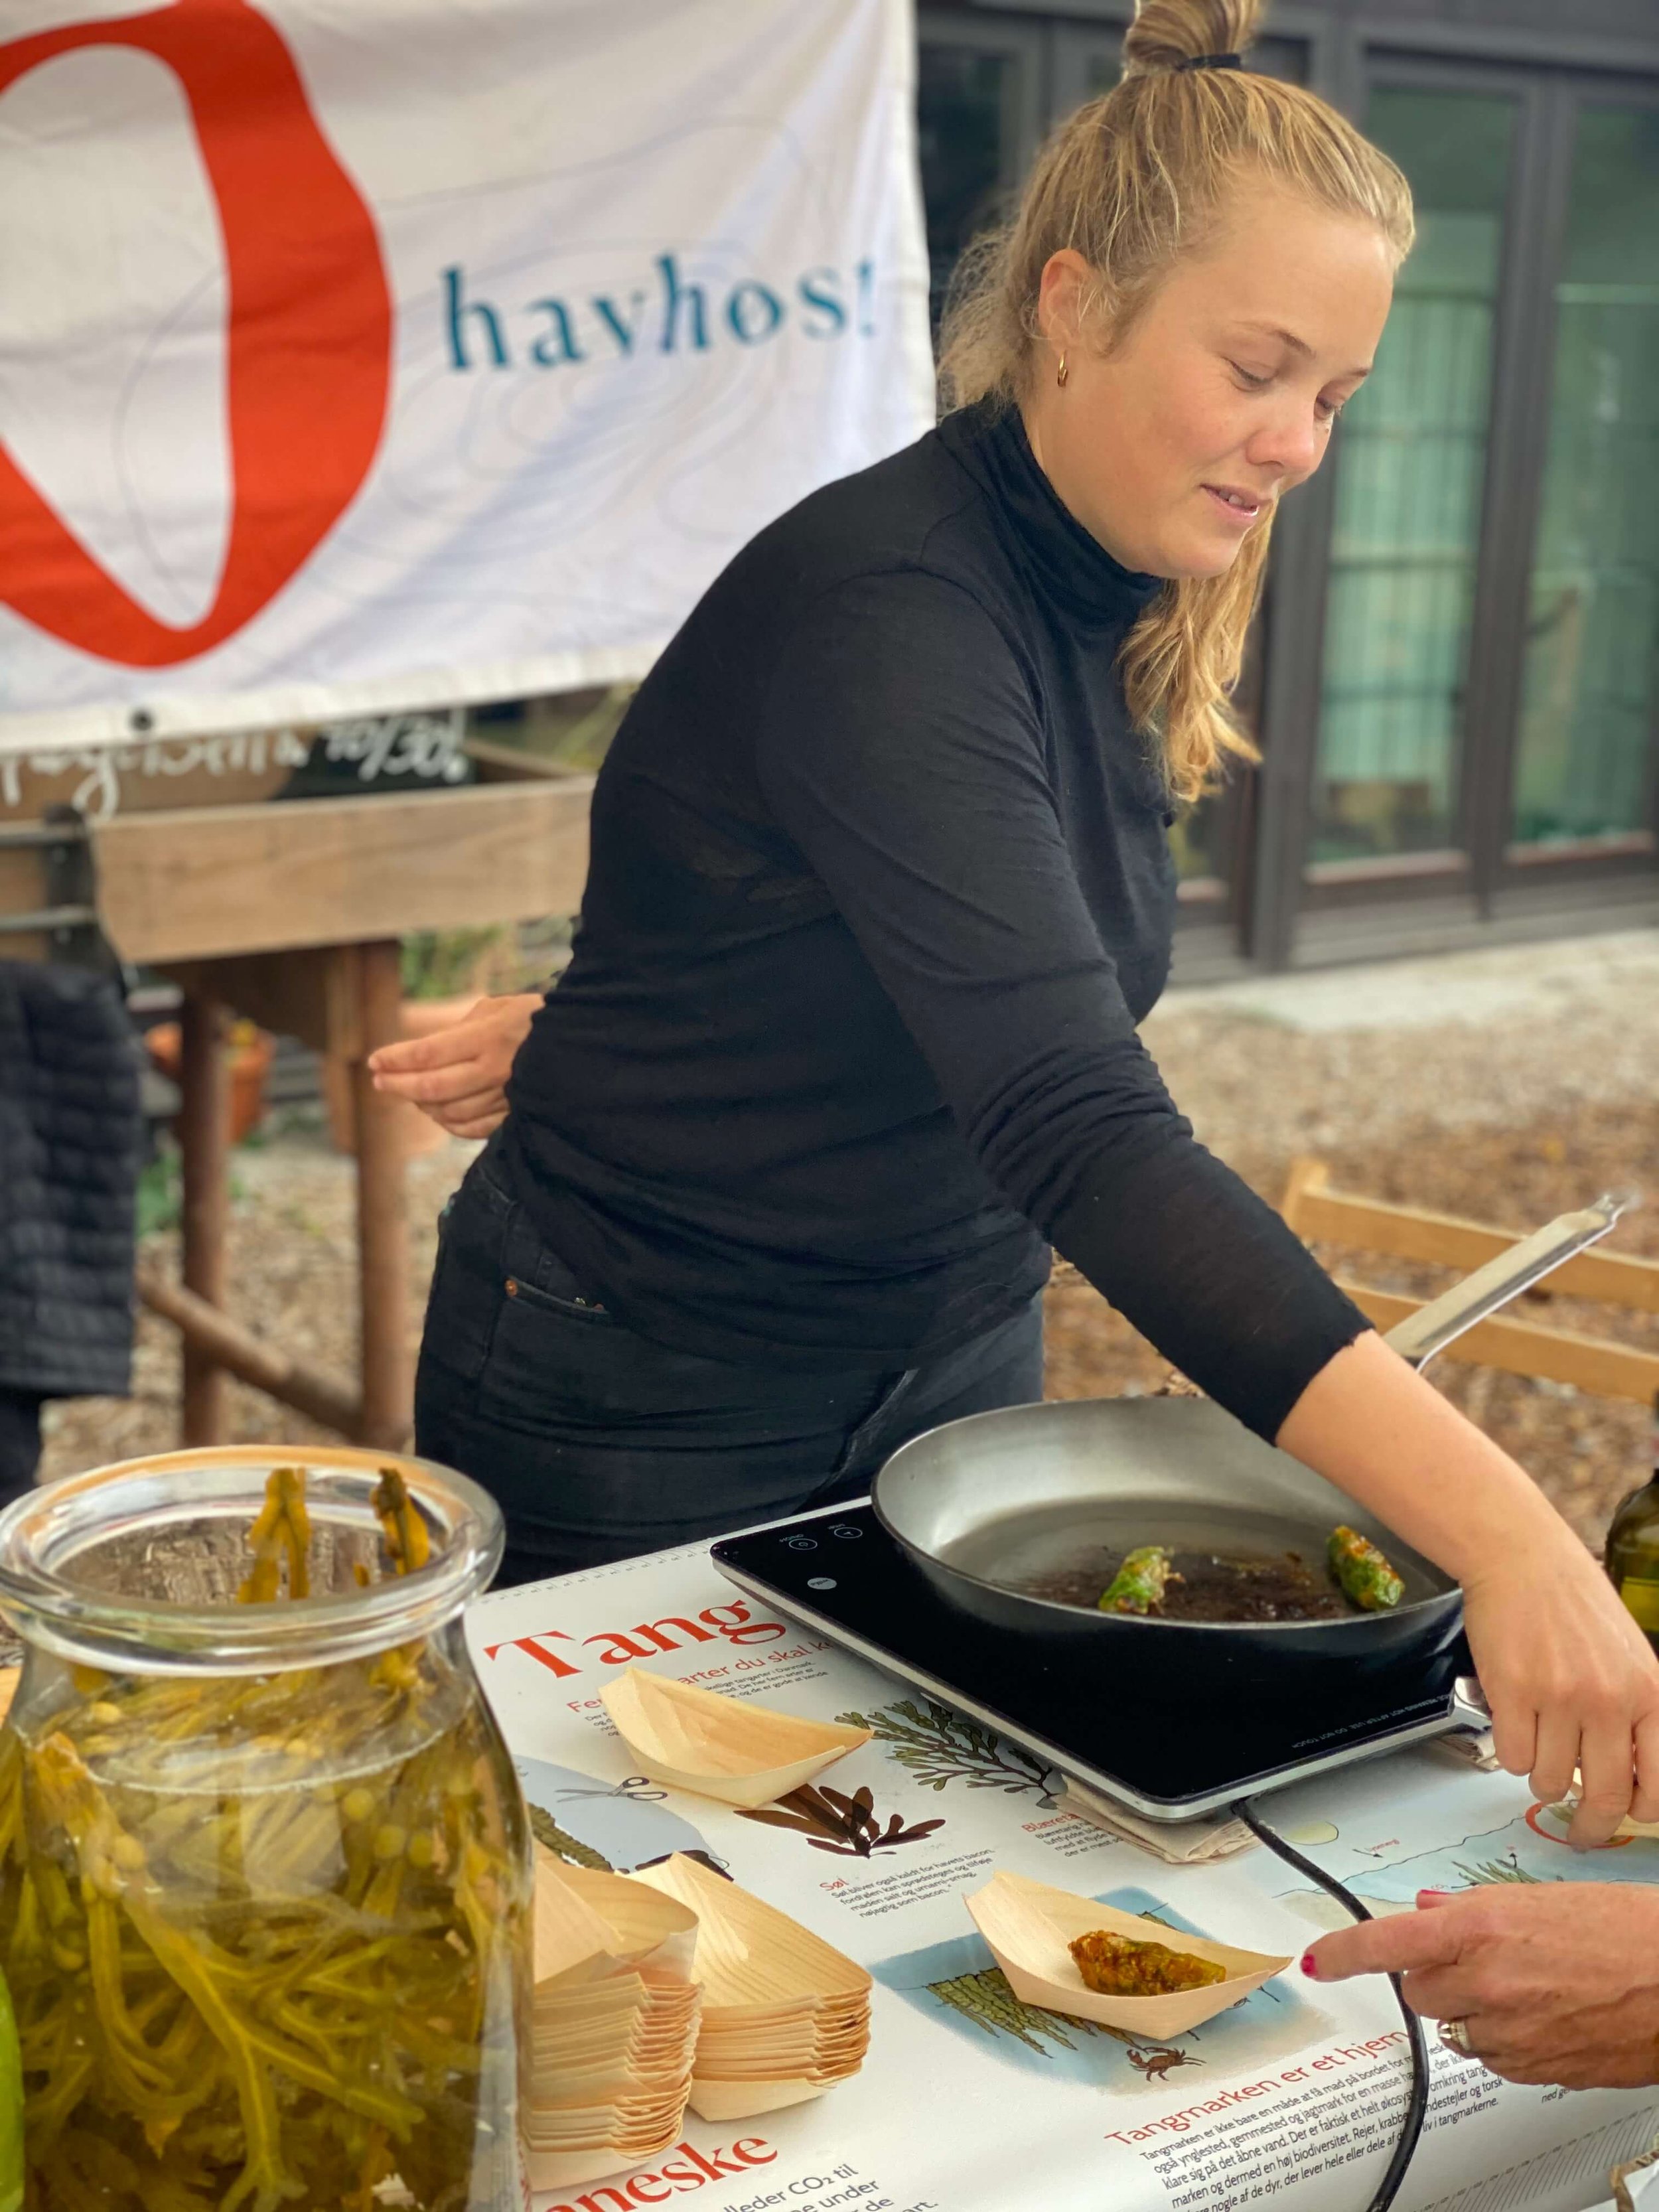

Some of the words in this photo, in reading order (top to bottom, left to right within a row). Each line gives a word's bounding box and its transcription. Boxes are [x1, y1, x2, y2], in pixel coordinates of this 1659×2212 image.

[482, 1599, 786, 1678] Tang
[566, 1699, 602, 1712] Fe
[678, 1666, 731, 1684] arter
[735, 1659, 766, 1670] du
[768, 1645, 812, 1662] skal
[1021, 1813, 1080, 1832] Blæreta
[820, 1878, 849, 1891] Søl
[847, 1883, 875, 1893] bliver
[876, 1876, 898, 1885] også
[896, 1870, 920, 1879] kaldt
[932, 1858, 964, 1868] havets
[897, 1897, 918, 1906] som
[1104, 2080, 1281, 2144] Tangmarken
[1281, 2066, 1311, 2083] er
[1311, 2055, 1346, 2070] et
[1333, 2031, 1409, 2059] hjem
[1139, 2134, 1204, 2160] Tangmarken
[1203, 2129, 1214, 2138] er
[1212, 2122, 1236, 2134] ikke
[1233, 2113, 1258, 2126] bare
[1258, 2108, 1273, 2117] en
[1272, 2097, 1301, 2112] måde
[1301, 2093, 1311, 2101] at
[1310, 2087, 1323, 2097] få
[1323, 2079, 1346, 2093] mad
[1345, 2074, 1359, 2087] på
[1356, 2064, 1392, 2080] bordet
[1388, 2058, 1405, 2068] for
[1154, 2157, 1178, 2174] også
[1178, 2138, 1231, 2166] ynglested,
[1230, 2116, 1288, 2148] gemmested
[1288, 2113, 1304, 2124] og
[1299, 2096, 1344, 2122] jagtmark
[1341, 2093, 1357, 2103] for
[1358, 2088, 1371, 2097] en
[1370, 2076, 1402, 2091] masse
[1435, 2057, 1450, 2070] der
[1541, 2089, 1557, 2103] ned
[1161, 2174, 1189, 2190] klare
[1189, 2168, 1206, 2181] sig
[1204, 2164, 1218, 2179] på
[1218, 2156, 1236, 2169] det
[1236, 2146, 1262, 2163] åbne
[1262, 2134, 1289, 2153] vand.
[1288, 2128, 1307, 2143] Der
[1309, 2126, 1319, 2136] er
[1319, 2112, 1351, 2132] faktisk
[1350, 2110, 1359, 2120] et
[1359, 2099, 1382, 2118] helt
[1429, 2072, 1465, 2092] omkring
[1172, 2186, 1209, 2209] marken
[1210, 2183, 1224, 2195] og
[1224, 2163, 1262, 2188] dermed
[1263, 2162, 1276, 2174] en
[1277, 2154, 1293, 2168] høj
[1293, 2134, 1352, 2163] biodiversitet.
[1352, 2124, 1378, 2140] Rejer,
[1378, 2111, 1409, 2130] krabbe
[1425, 2089, 1467, 2114] ndestejler
[1470, 2085, 1481, 2097] og
[1482, 2075, 1503, 2093] torsk
[1212, 2195, 1238, 2212] nogle
[1240, 2187, 1249, 2203] af
[1251, 2184, 1263, 2199] de
[1265, 2179, 1283, 2194] dyr,
[1284, 2172, 1299, 2185] der
[1301, 2163, 1323, 2179] lever
[1325, 2154, 1344, 2170] hele
[1346, 2146, 1365, 2162] eller
[1367, 2138, 1386, 2154] dele
[1388, 2132, 1396, 2145] af
[1438, 2097, 1499, 2126] tangmarkerne.
[545, 2138, 778, 2212] neske
[818, 2180, 879, 2208] under
[833, 2164, 859, 2179] til
[865, 2198, 895, 2211] de
